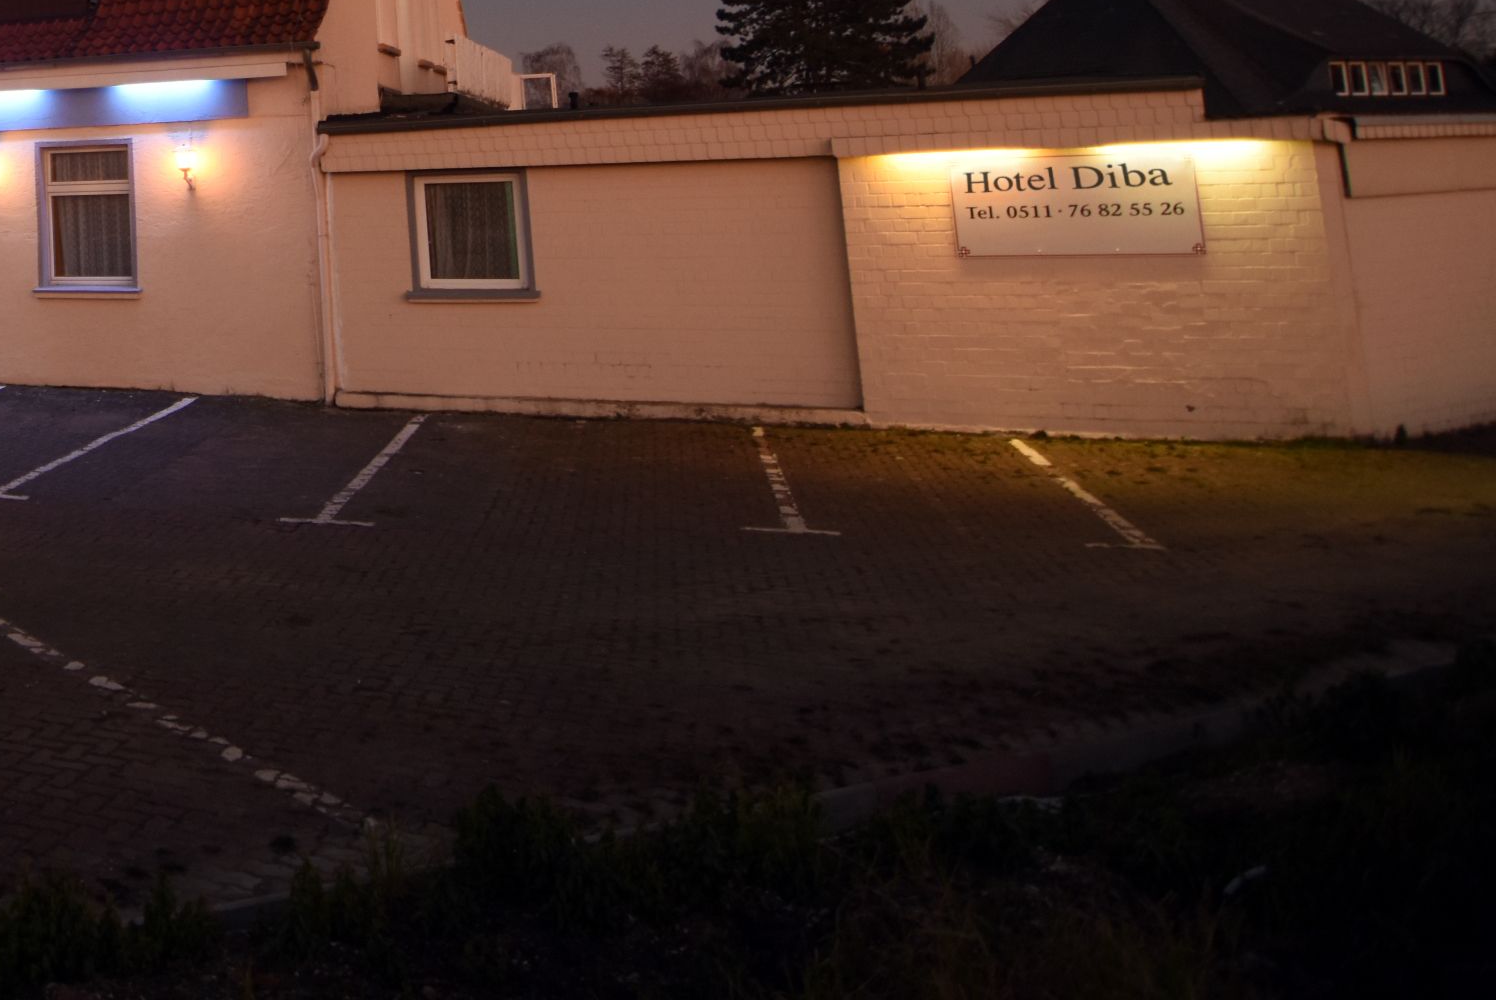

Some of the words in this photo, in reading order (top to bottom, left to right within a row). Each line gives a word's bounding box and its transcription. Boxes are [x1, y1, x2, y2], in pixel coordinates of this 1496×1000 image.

[964, 165, 1059, 194] Hotel
[1069, 162, 1173, 190] Diba
[966, 206, 1001, 220] Tel.
[1006, 204, 1052, 219] 0511
[1067, 204, 1092, 218] 76
[1097, 203, 1123, 217] 82
[1129, 202, 1153, 216] 55
[1160, 201, 1185, 216] 26
